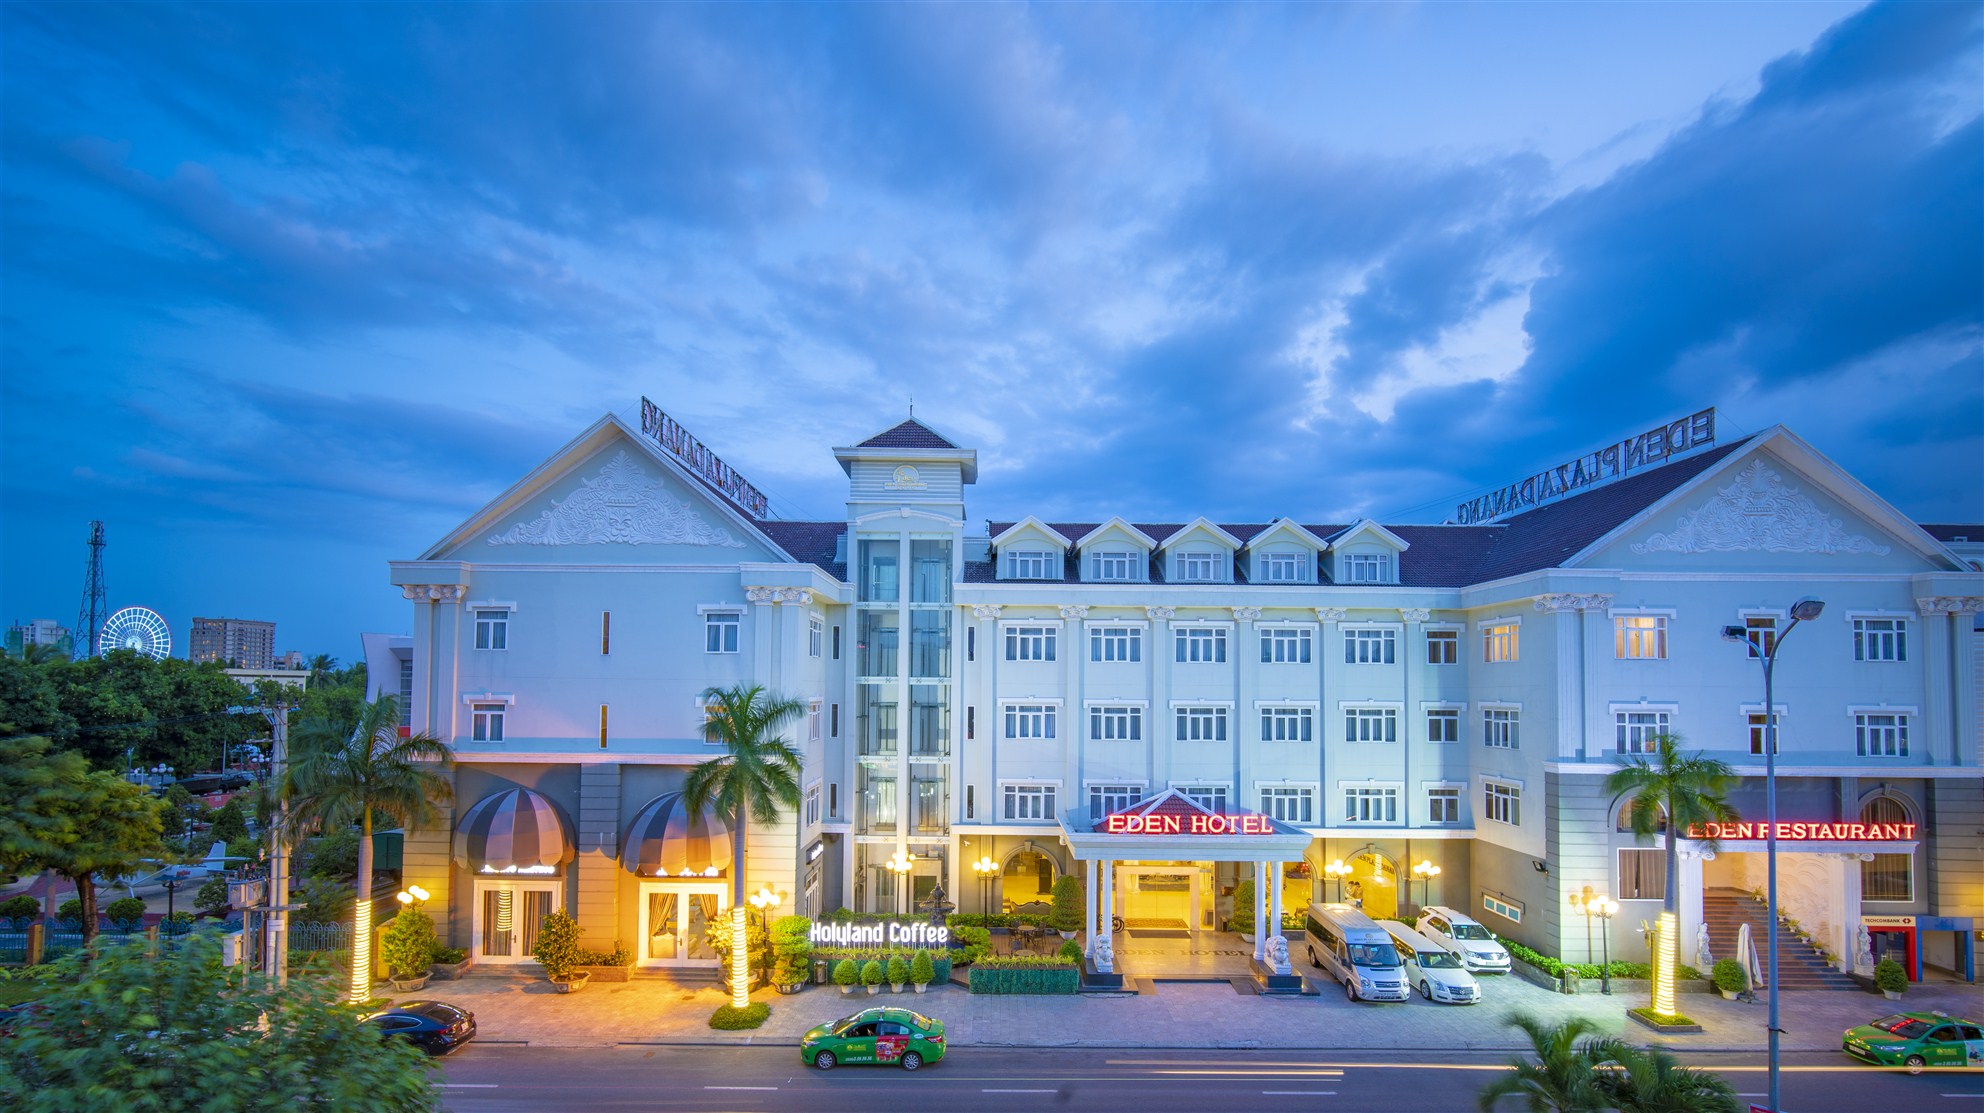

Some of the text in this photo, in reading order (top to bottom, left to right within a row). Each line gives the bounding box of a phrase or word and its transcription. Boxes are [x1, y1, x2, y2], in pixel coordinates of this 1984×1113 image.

[1108, 814, 1273, 833] EDEN HOTEL
[1687, 822, 1916, 840] EDEN RESTAURANT
[810, 921, 949, 946] Holyland Coffee
